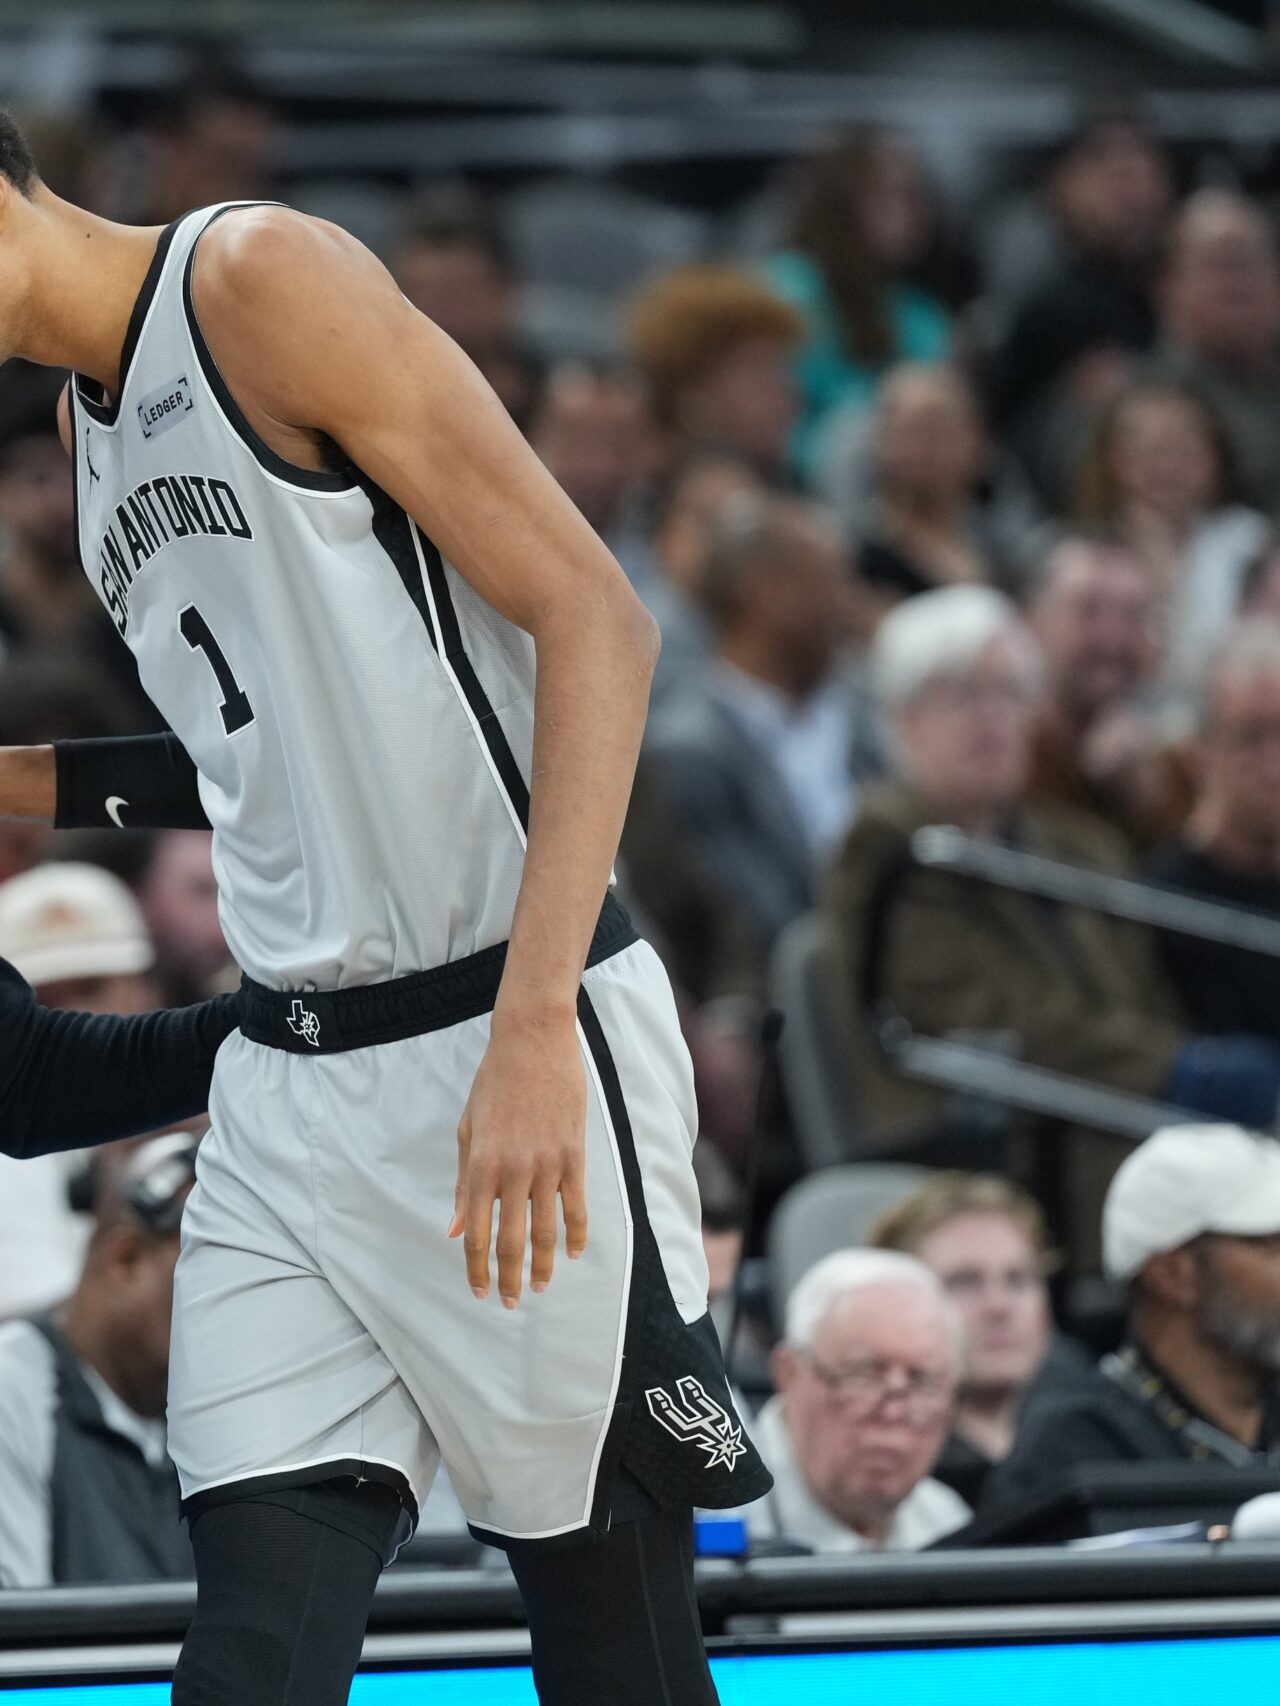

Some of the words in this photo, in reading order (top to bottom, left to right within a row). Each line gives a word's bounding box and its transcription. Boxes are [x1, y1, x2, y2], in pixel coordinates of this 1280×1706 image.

[144, 391, 184, 426] LEDGER
[115, 475, 254, 572] ANTONIO
[100, 522, 134, 638] SAN
[179, 603, 256, 737] 1
